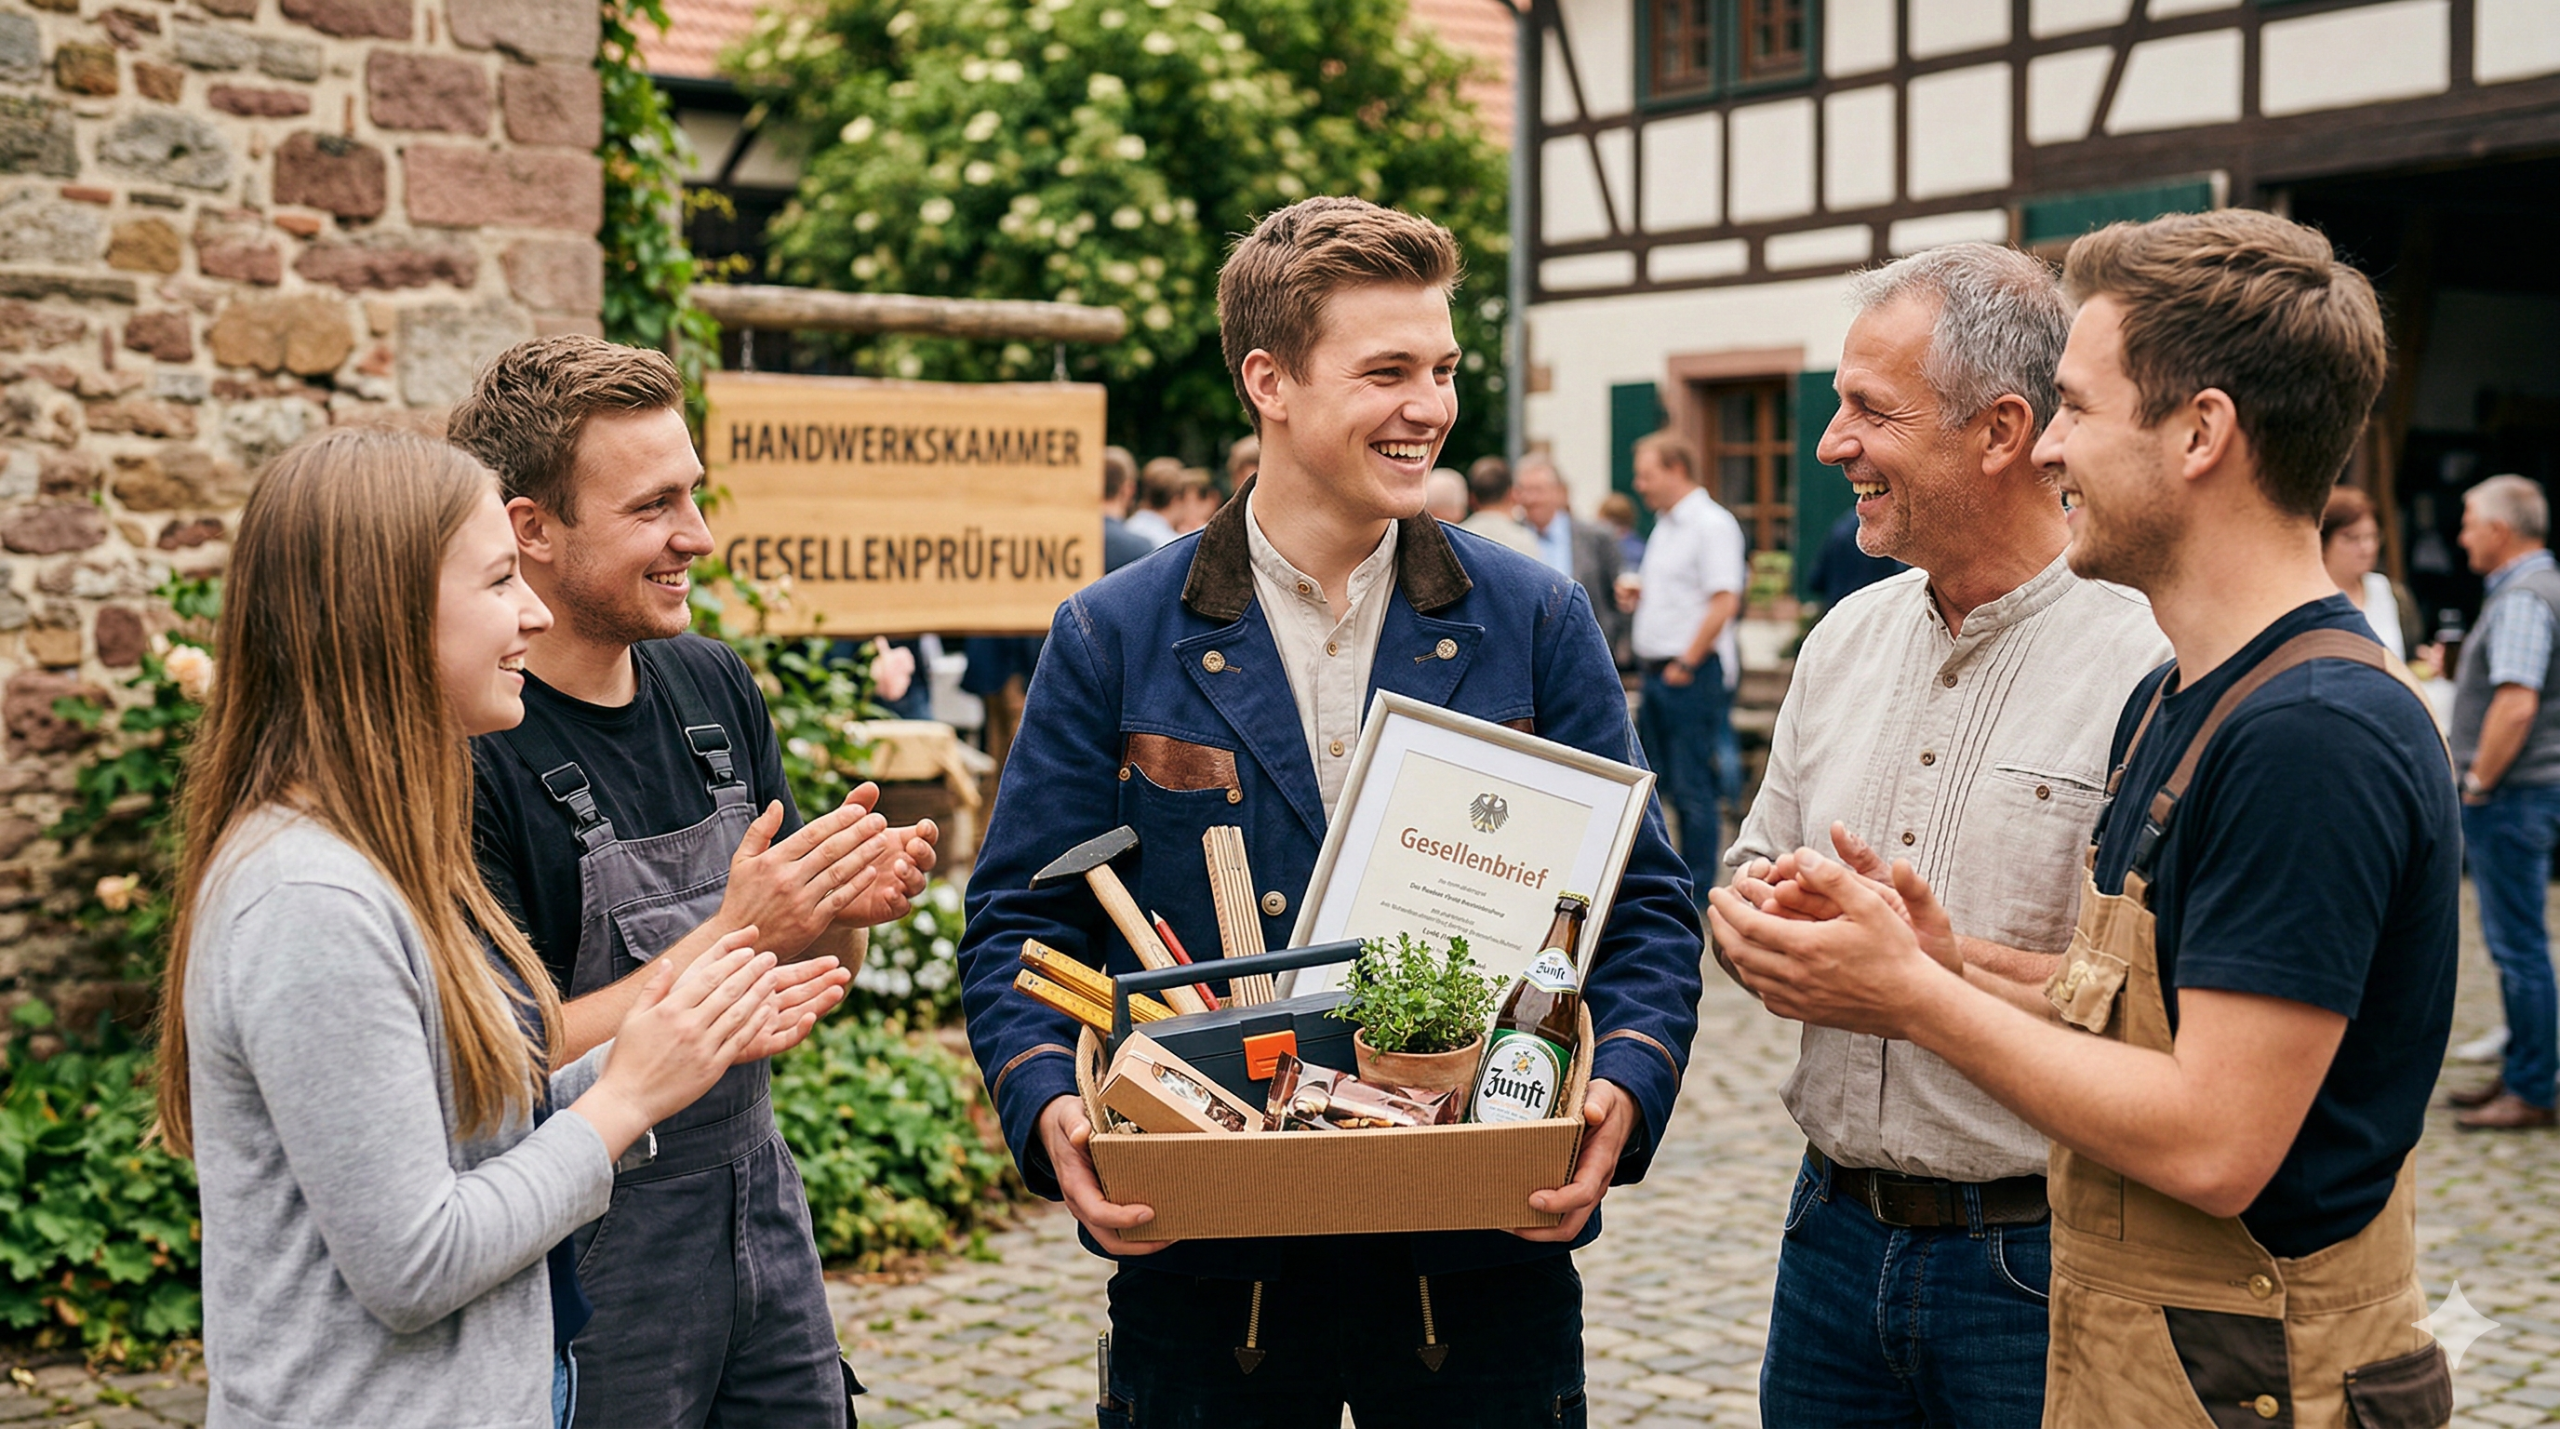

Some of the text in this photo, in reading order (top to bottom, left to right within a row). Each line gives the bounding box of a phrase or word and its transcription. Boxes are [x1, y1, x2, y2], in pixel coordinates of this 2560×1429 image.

[731, 423, 1081, 466] HANDWERKSKAMMER
[727, 527, 1082, 581] GESELLENPRÜFUNG
[1400, 827, 1549, 890] Gesellenbrief
[1536, 962, 1566, 981] Zunft
[1483, 1067, 1546, 1109] Zunft
